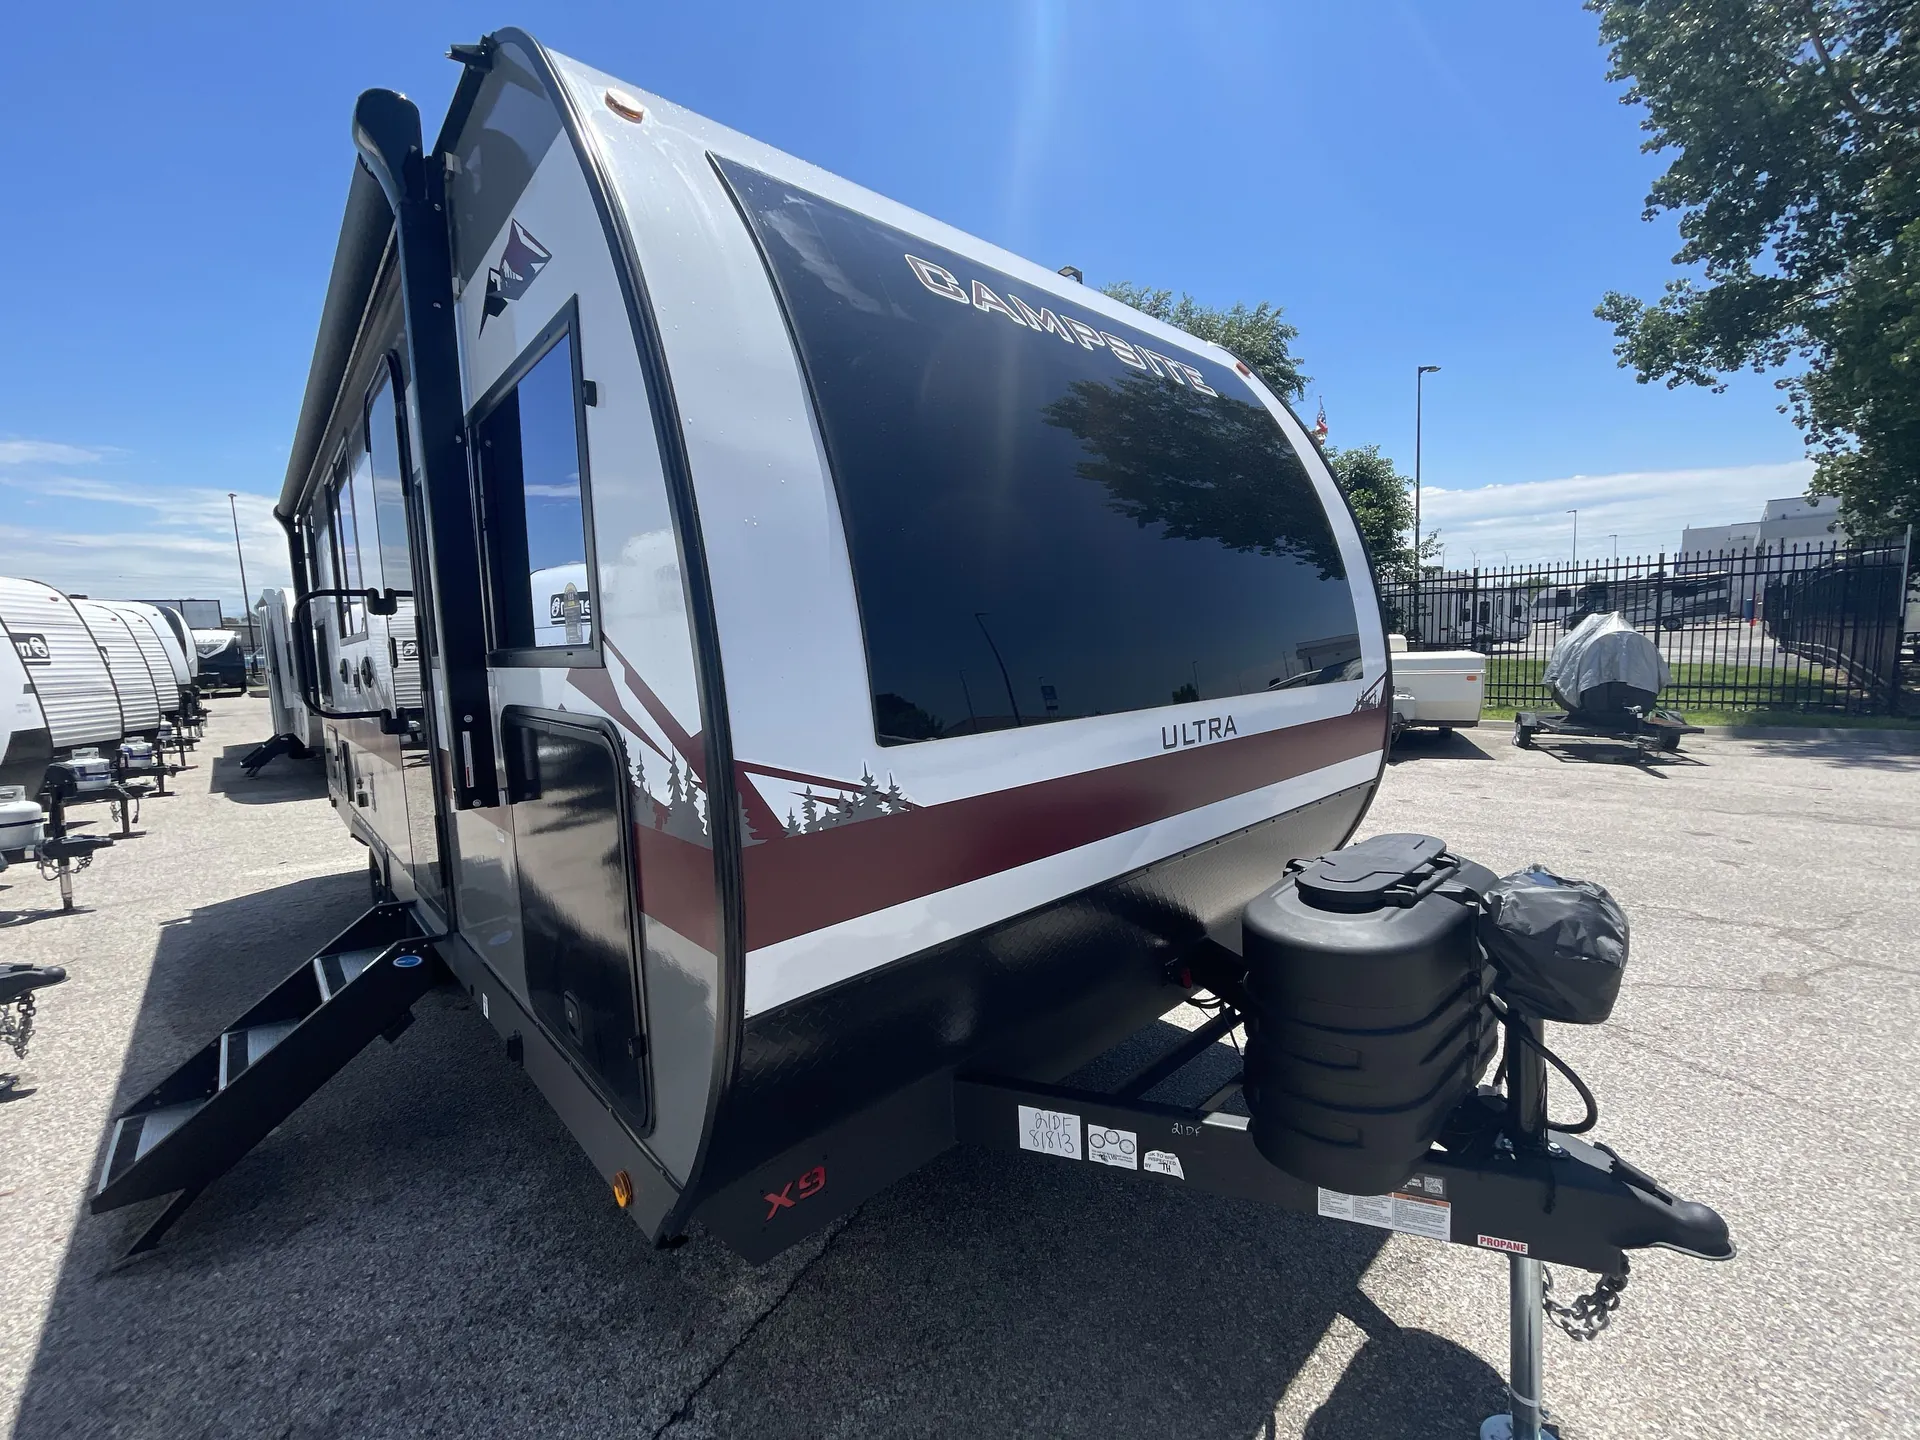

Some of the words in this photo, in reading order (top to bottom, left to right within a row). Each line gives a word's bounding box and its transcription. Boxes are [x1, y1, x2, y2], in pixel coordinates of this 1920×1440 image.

[905, 254, 1218, 398] CAMPSITE
[1161, 714, 1237, 749] ULTRA
[1034, 1112, 1073, 1134] 21DF
[1028, 1130, 1075, 1154] 81813
[764, 1165, 826, 1222] X9
[1479, 1236, 1527, 1253] PROPANE
